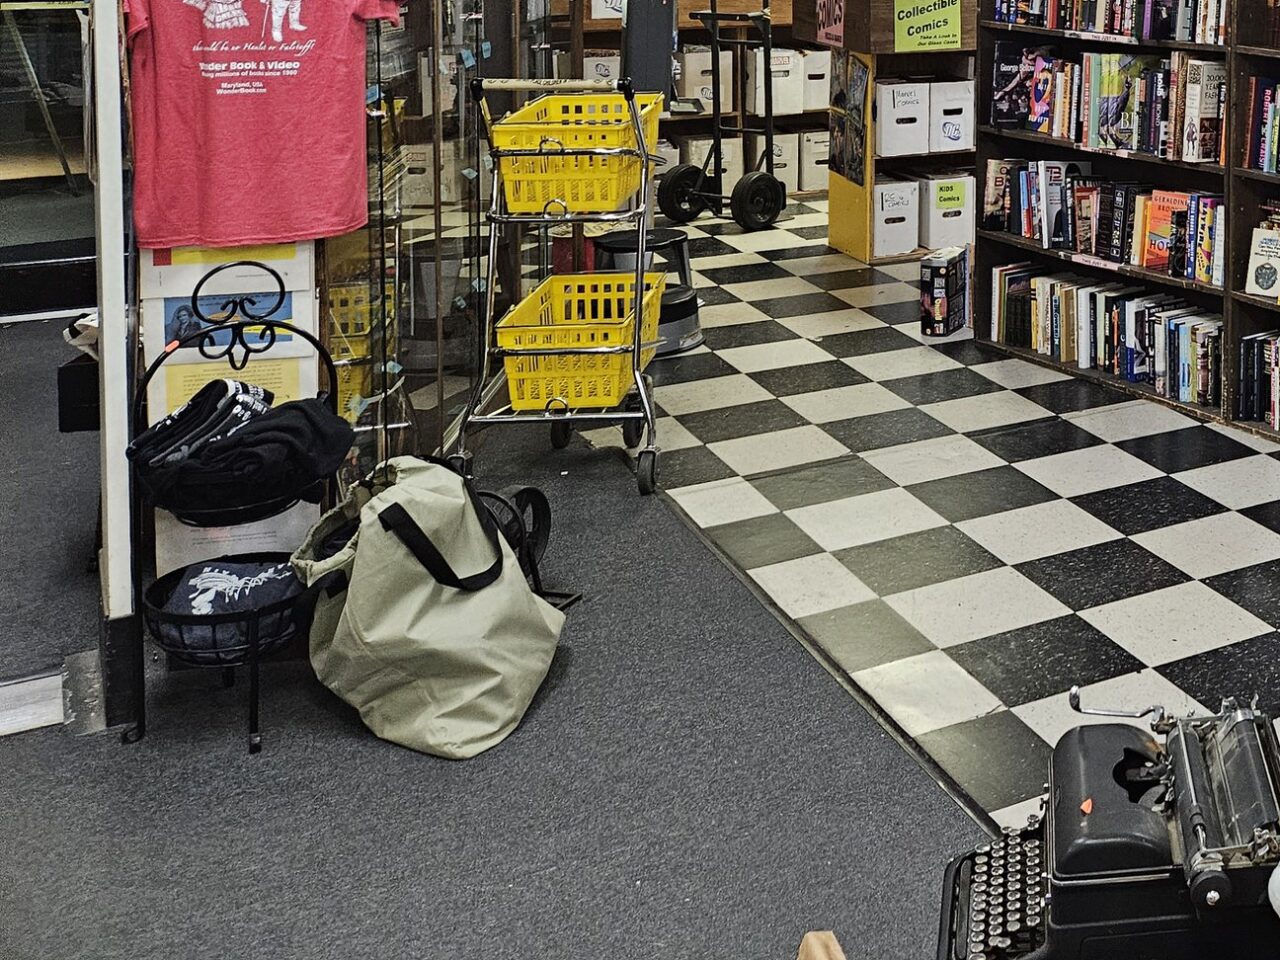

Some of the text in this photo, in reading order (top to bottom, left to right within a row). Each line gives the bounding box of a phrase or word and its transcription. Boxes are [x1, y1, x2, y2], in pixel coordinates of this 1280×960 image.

[906, 17, 949, 37] Comics
[230, 61, 257, 71] Book
[267, 60, 301, 70] Video
[939, 185, 954, 193] KIDS
[938, 195, 960, 203] Comics
